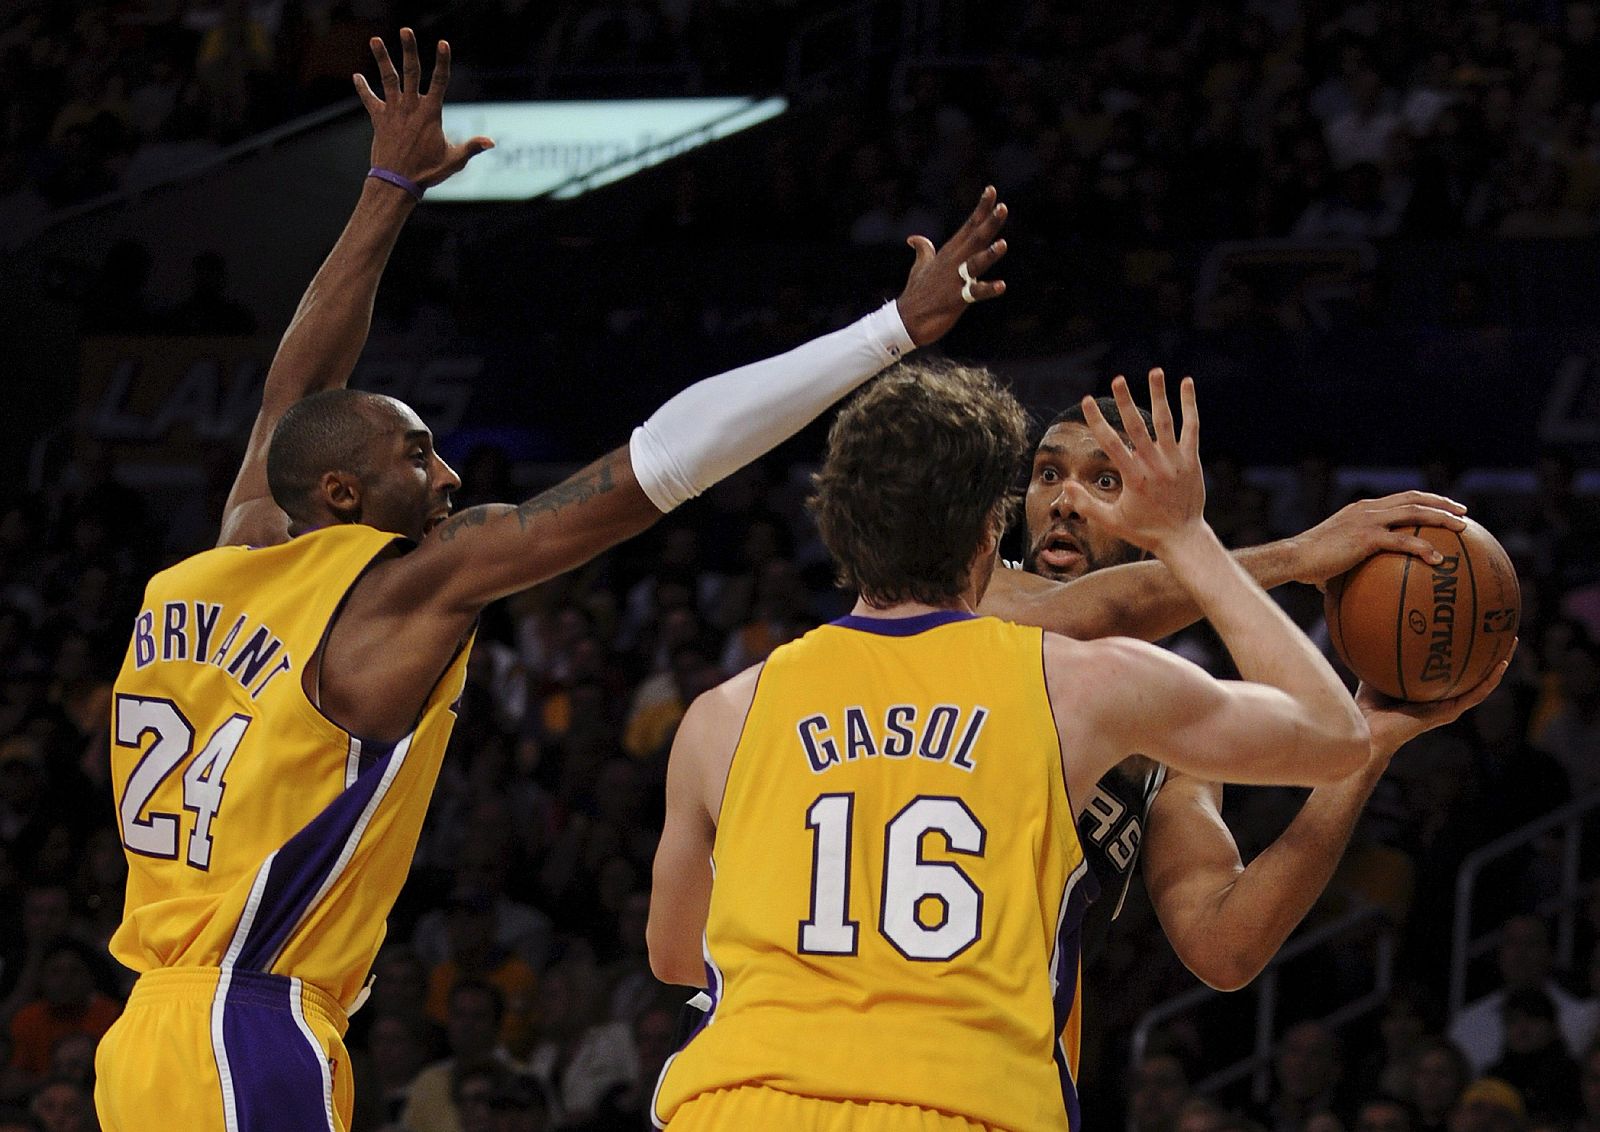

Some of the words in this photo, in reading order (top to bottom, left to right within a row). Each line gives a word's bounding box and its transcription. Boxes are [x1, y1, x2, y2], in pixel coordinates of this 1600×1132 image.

[134, 599, 292, 701] BRYANT
[1420, 550, 1460, 683] SPALDING
[115, 692, 253, 872] 24
[796, 703, 990, 775] GASOL
[797, 791, 988, 962] 16
